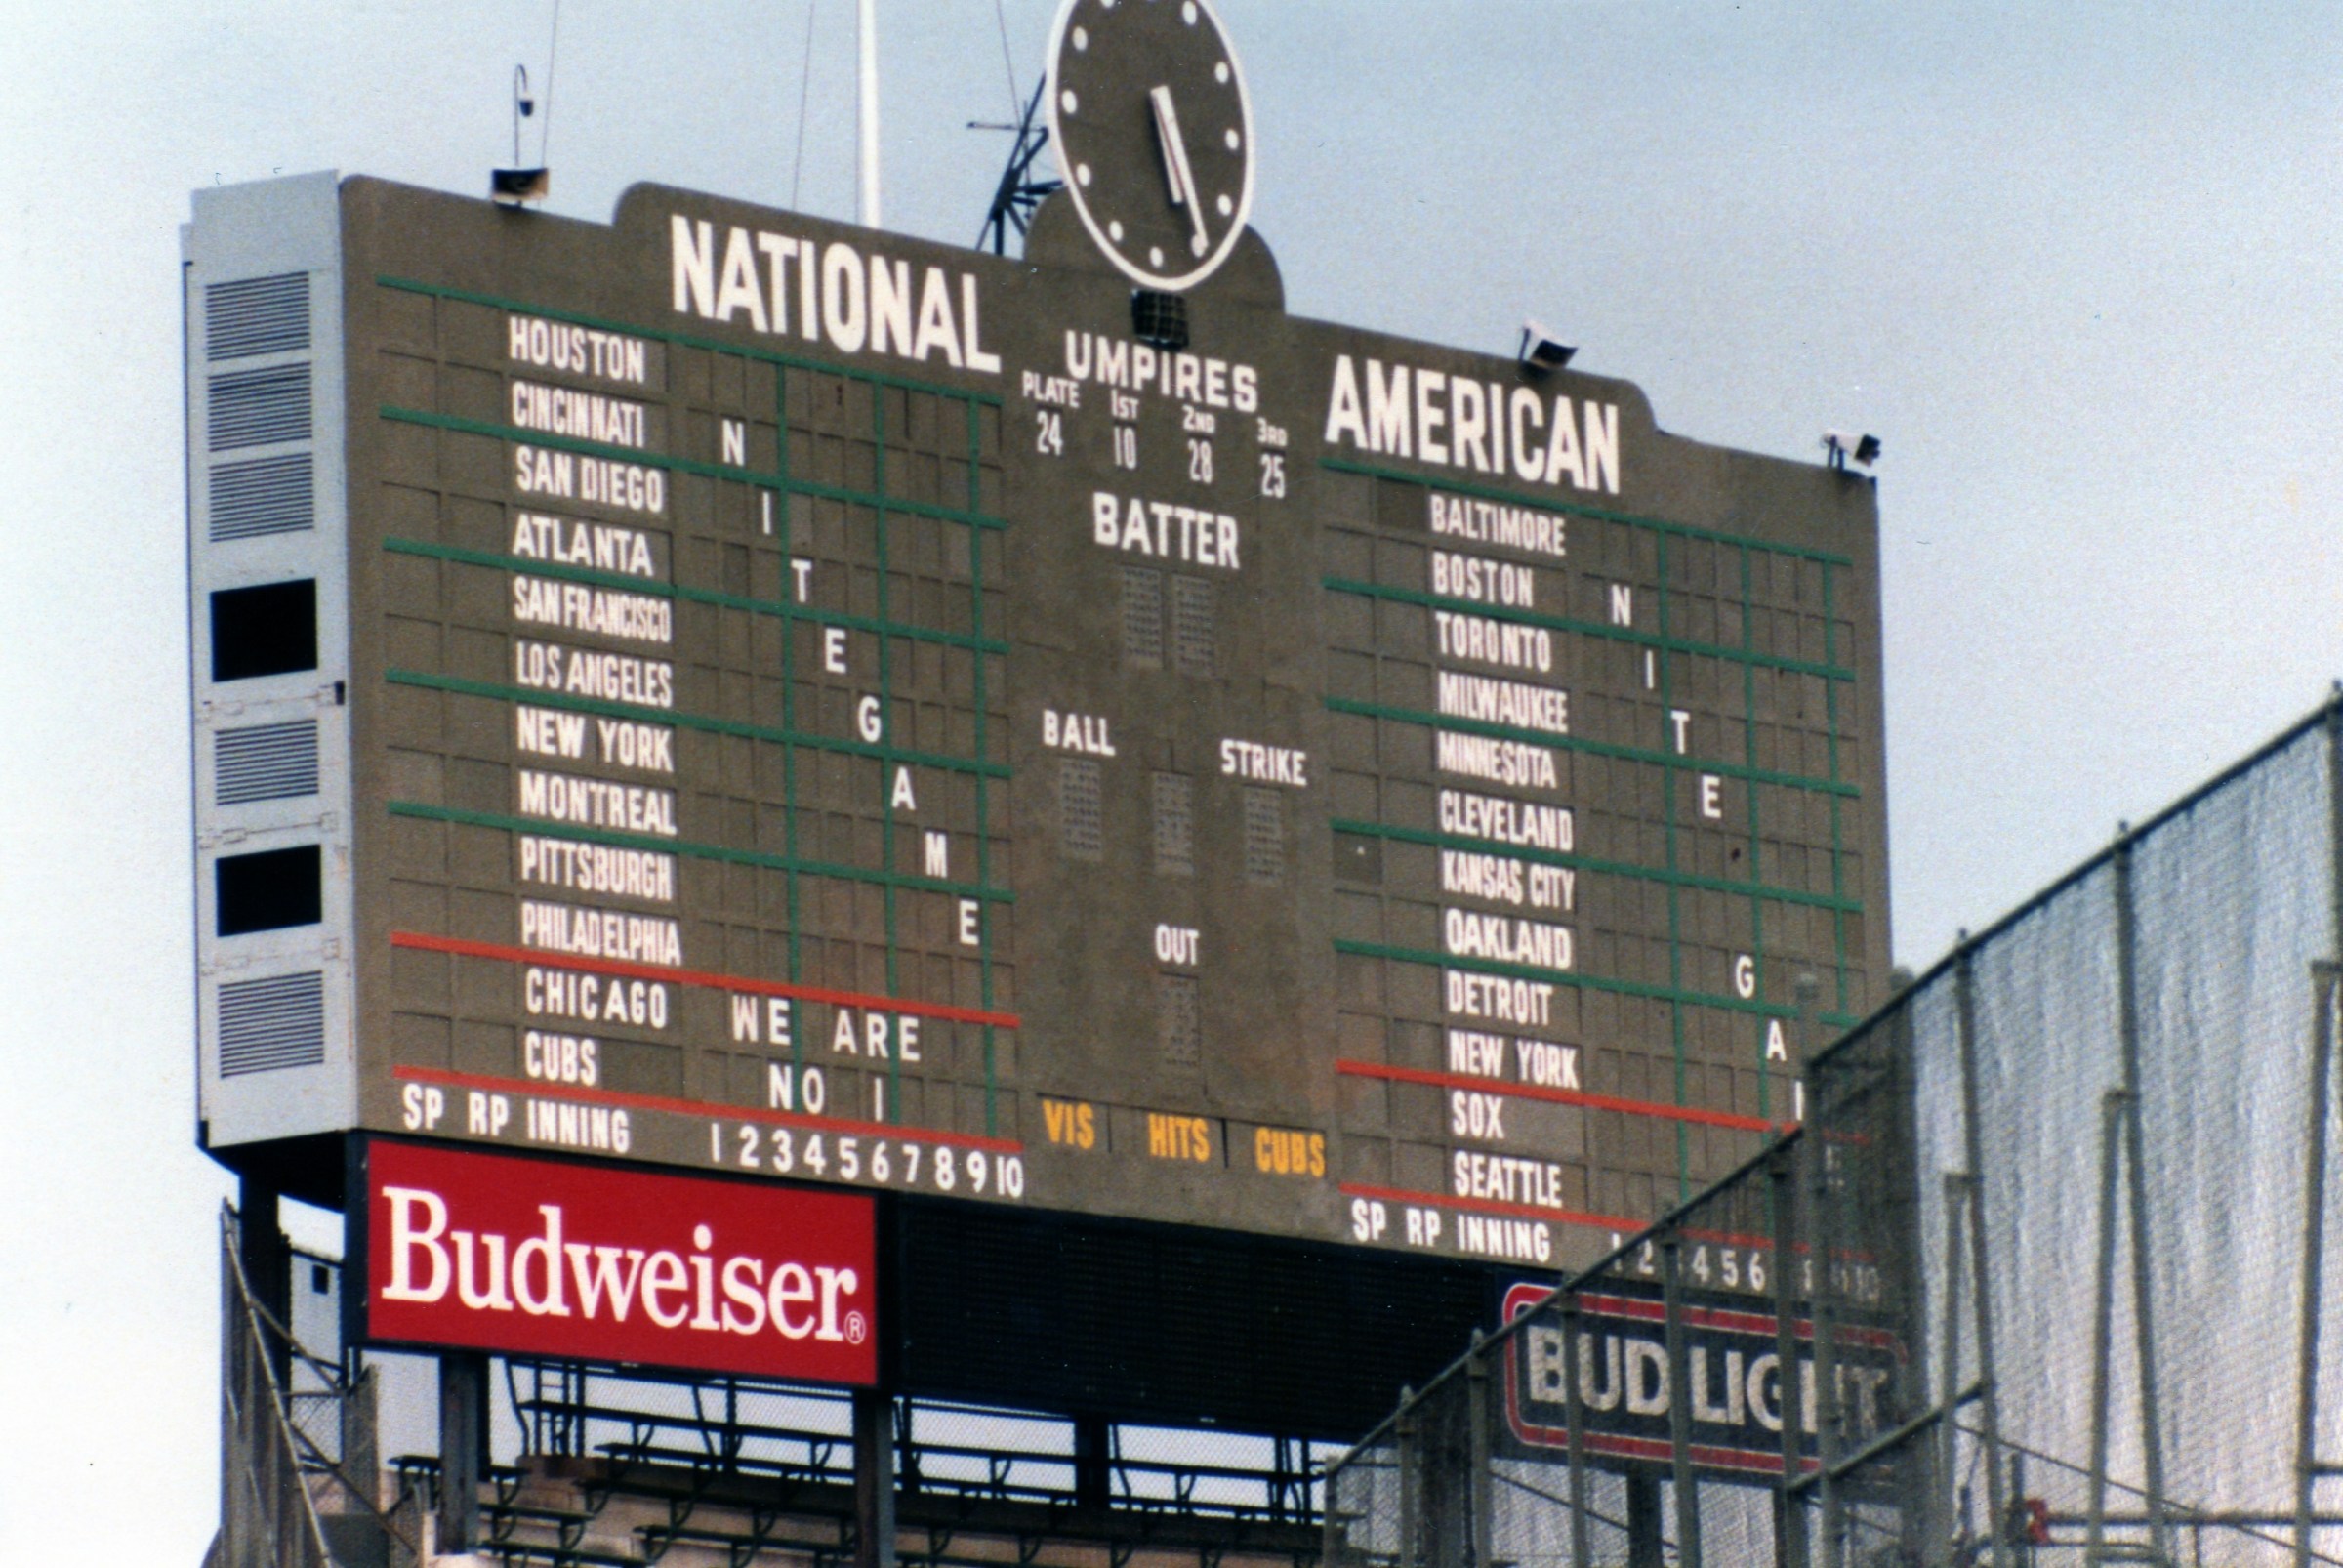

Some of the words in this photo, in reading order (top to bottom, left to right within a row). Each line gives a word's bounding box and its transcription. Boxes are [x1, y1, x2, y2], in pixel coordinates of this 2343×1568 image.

[671, 214, 1002, 374] NATIONAL
[510, 316, 645, 384] HOUSTON
[1064, 330, 1258, 414] UMPIRES
[512, 383, 645, 449] CINCINNATI
[1022, 369, 1080, 408] PLATE
[1037, 410, 1063, 455] 24
[1114, 427, 1136, 470] 10
[1187, 438, 1213, 483] 28
[1260, 453, 1286, 499] 25
[1324, 353, 1621, 495] AMERICAN
[515, 445, 574, 498] SAN
[580, 457, 664, 514] DIEGO
[513, 513, 654, 578] ATLANTA
[1092, 491, 1240, 569] BATTER
[1430, 494, 1566, 557] BALTIMORE
[514, 575, 562, 625] SAN
[562, 584, 672, 643] FRANCISCO
[1432, 551, 1533, 608] BOSTON
[1434, 611, 1552, 673] TORONTO
[516, 641, 562, 690] LOS
[565, 651, 673, 709] ANGELES
[1438, 670, 1568, 733] MILWAUKEE
[517, 706, 587, 759] NEW
[597, 719, 674, 773] YORK
[1043, 709, 1116, 757] BALL
[1220, 738, 1307, 786] STRIKE
[1437, 731, 1557, 789] MINNESOTA
[519, 769, 678, 836] MONTREAL
[1439, 790, 1573, 852] CLEVELAND
[520, 836, 674, 901] PITTSBURGH
[1442, 850, 1524, 905] KANSAS
[1528, 863, 1575, 910] CITY
[521, 900, 682, 967] PHILADELPHIA
[1155, 923, 1200, 965] OUT
[1445, 907, 1573, 970] OAKLAND
[526, 967, 668, 1029] CHICAGO
[732, 995, 791, 1046] WE
[833, 1009, 921, 1061] ARE
[1446, 970, 1553, 1026] DETROIT
[524, 1030, 598, 1087] CUBS
[768, 1063, 825, 1114] NO
[1448, 1030, 1504, 1078] NEW
[1516, 1039, 1580, 1090] YORK
[402, 1082, 445, 1131] SP
[468, 1090, 511, 1136] RP
[526, 1098, 632, 1154] INNING
[995, 1155, 1024, 1199] 10
[1042, 1099, 1096, 1150] VIS
[1147, 1112, 1212, 1163] HITS
[1254, 1127, 1327, 1178] CUBS
[1451, 1090, 1506, 1139] SOX
[1453, 1150, 1563, 1209] SEATTLE
[1350, 1197, 1387, 1243] SP
[1405, 1206, 1442, 1247] RP
[1457, 1214, 1551, 1263] INNING
[1747, 1253, 1766, 1292] 6
[1527, 1324, 1671, 1416] BUD
